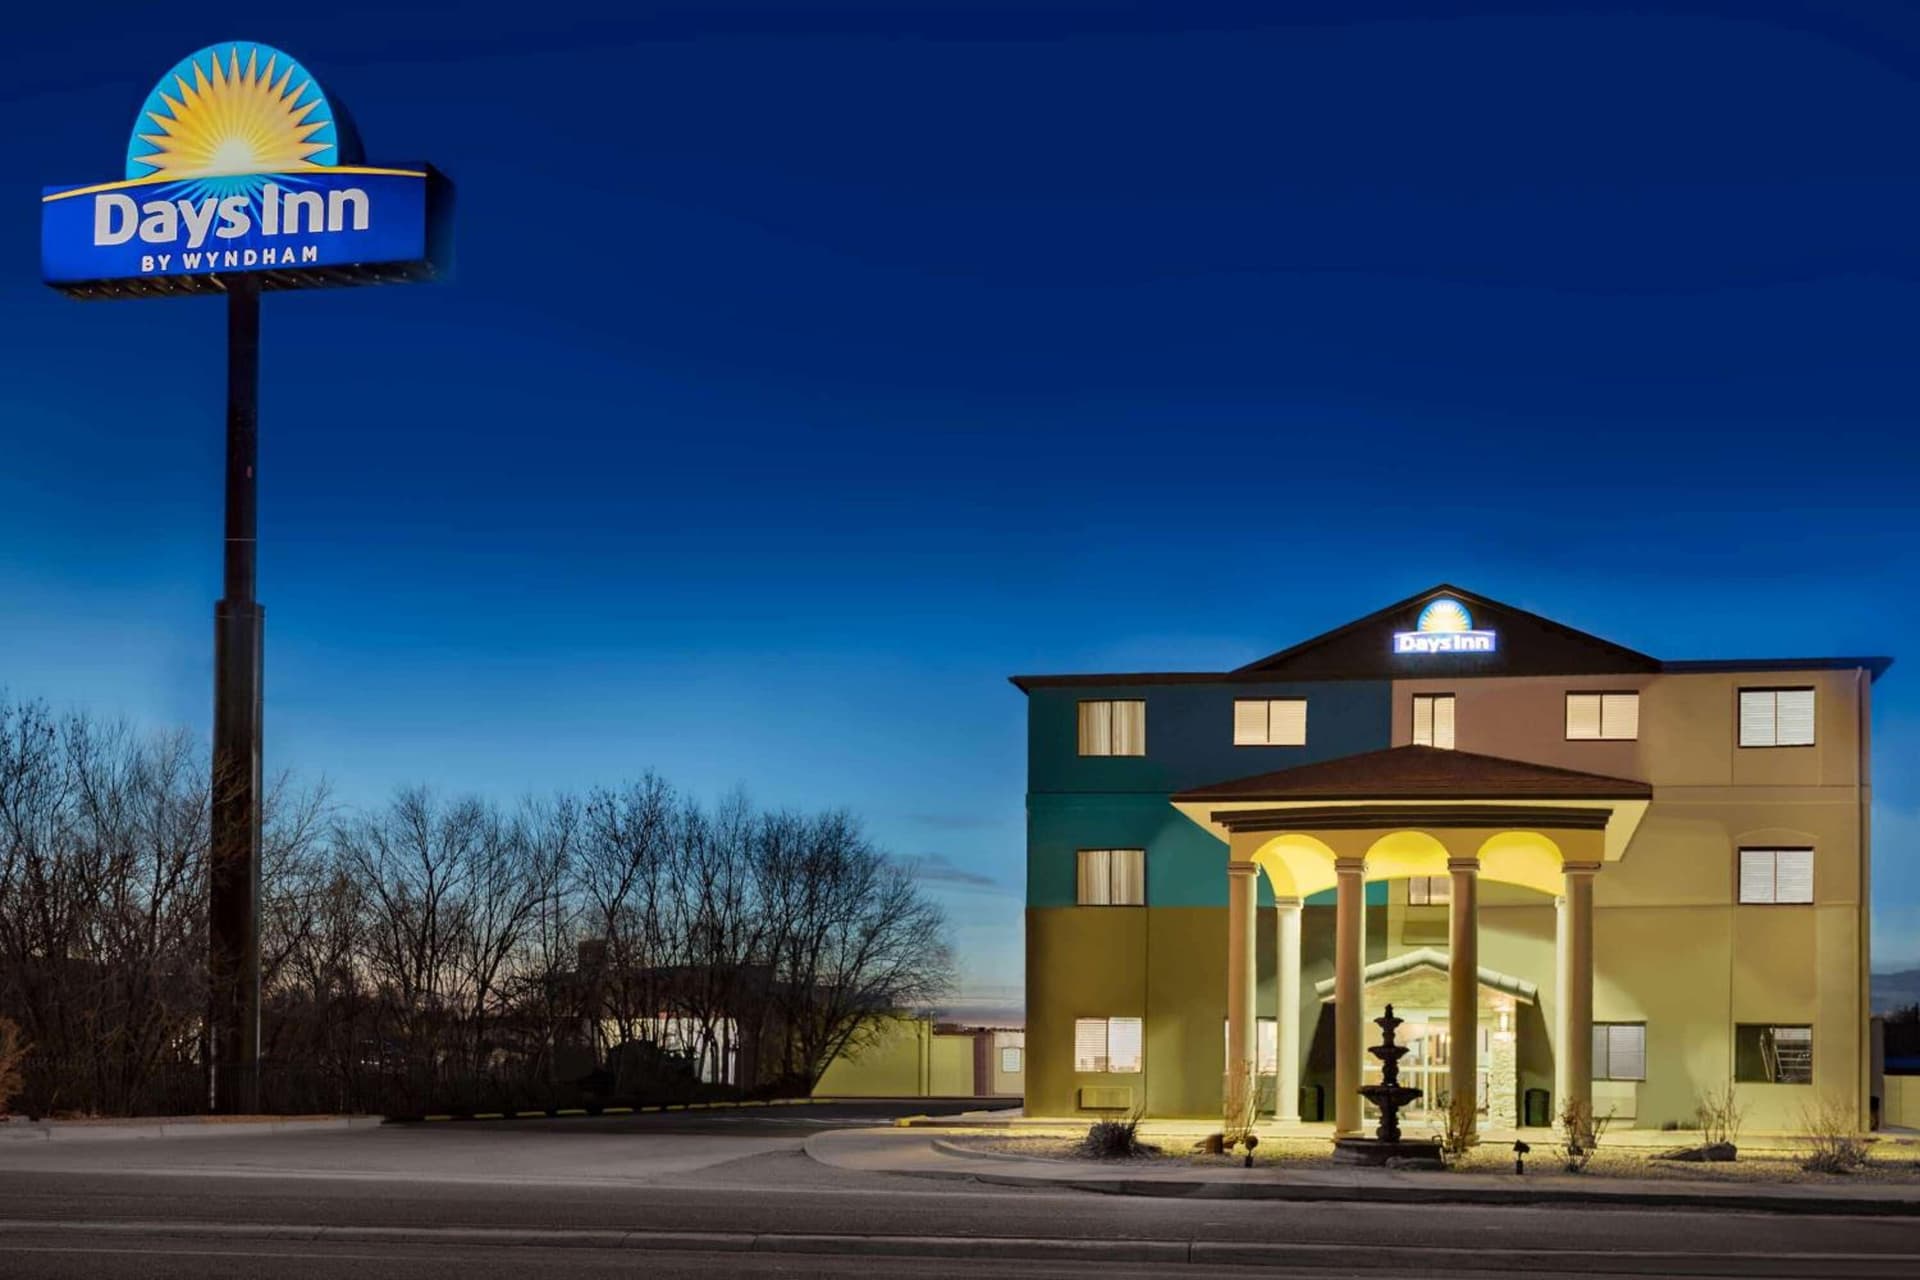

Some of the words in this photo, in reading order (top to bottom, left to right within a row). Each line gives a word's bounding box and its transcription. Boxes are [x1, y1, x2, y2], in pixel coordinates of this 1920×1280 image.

[94, 194, 250, 249] Days
[261, 184, 370, 236] Inn
[141, 254, 170, 273] BY
[183, 246, 318, 270] WYNDHAM
[1400, 636, 1451, 653] Days
[1453, 635, 1489, 650] Inn
